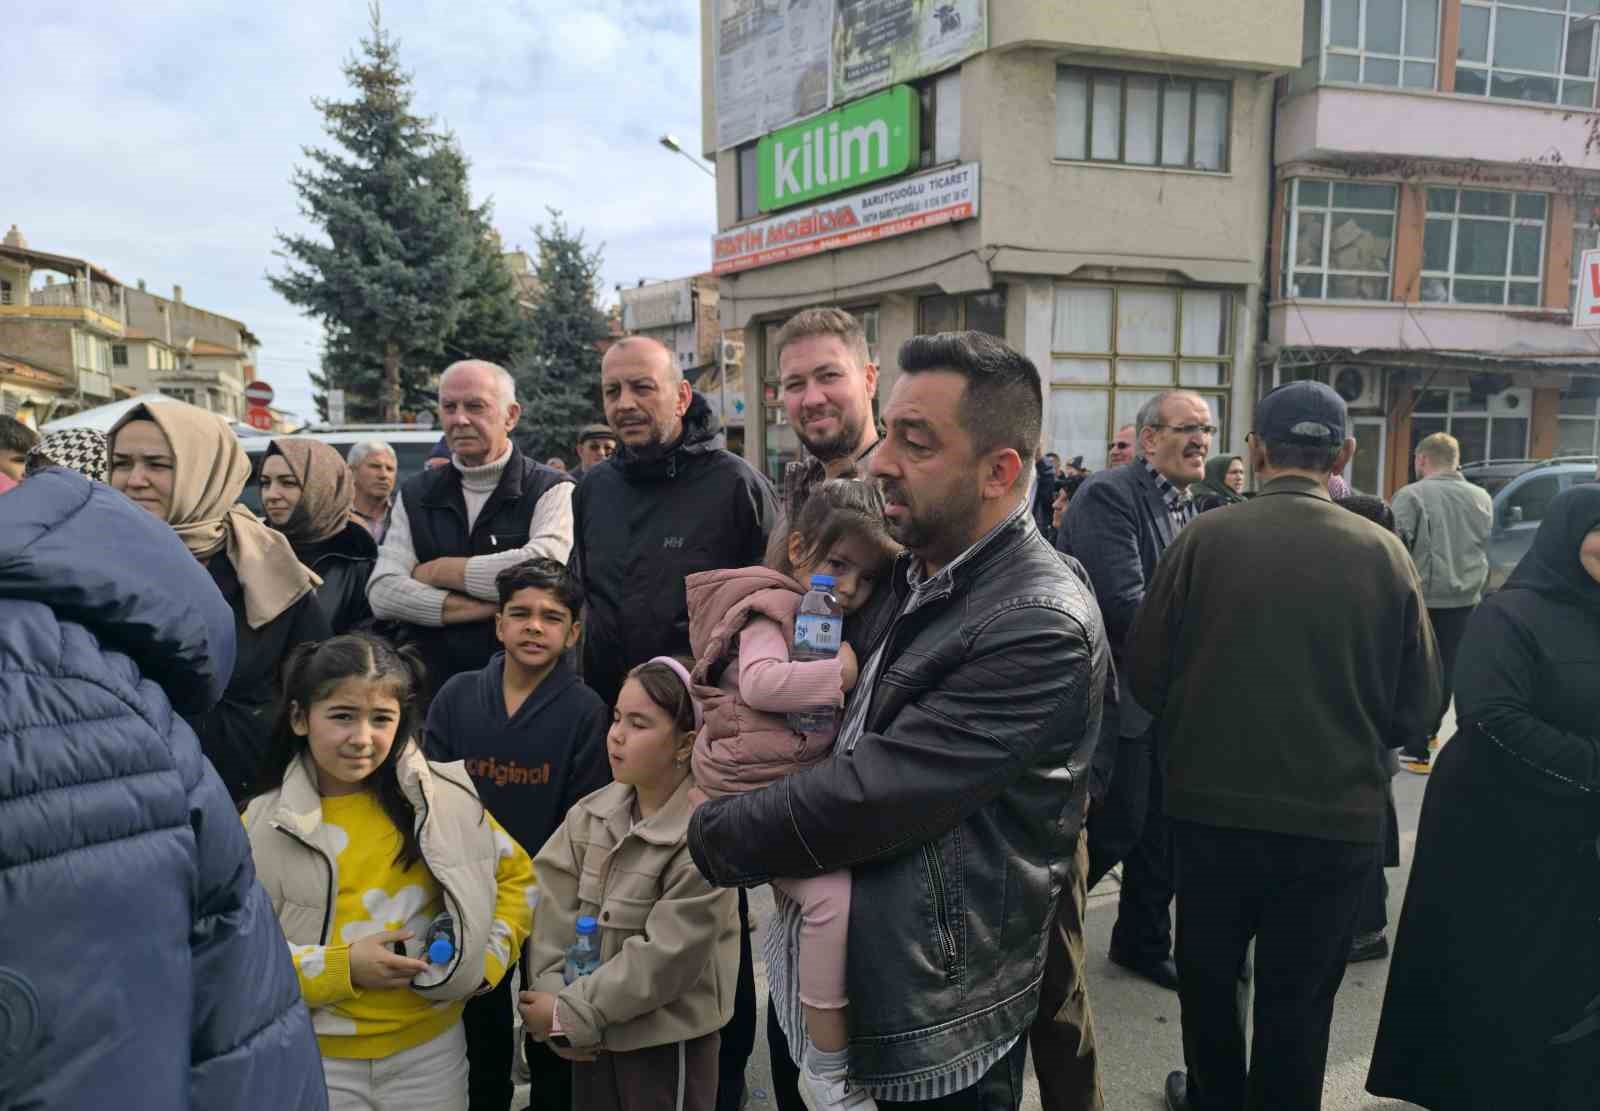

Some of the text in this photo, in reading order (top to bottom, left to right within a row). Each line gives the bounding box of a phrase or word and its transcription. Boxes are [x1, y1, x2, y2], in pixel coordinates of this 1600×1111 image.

[774, 118, 889, 199] kilim
[928, 170, 969, 191] TİCARET
[766, 205, 860, 244] MOBİLYA
[466, 758, 551, 786] original
